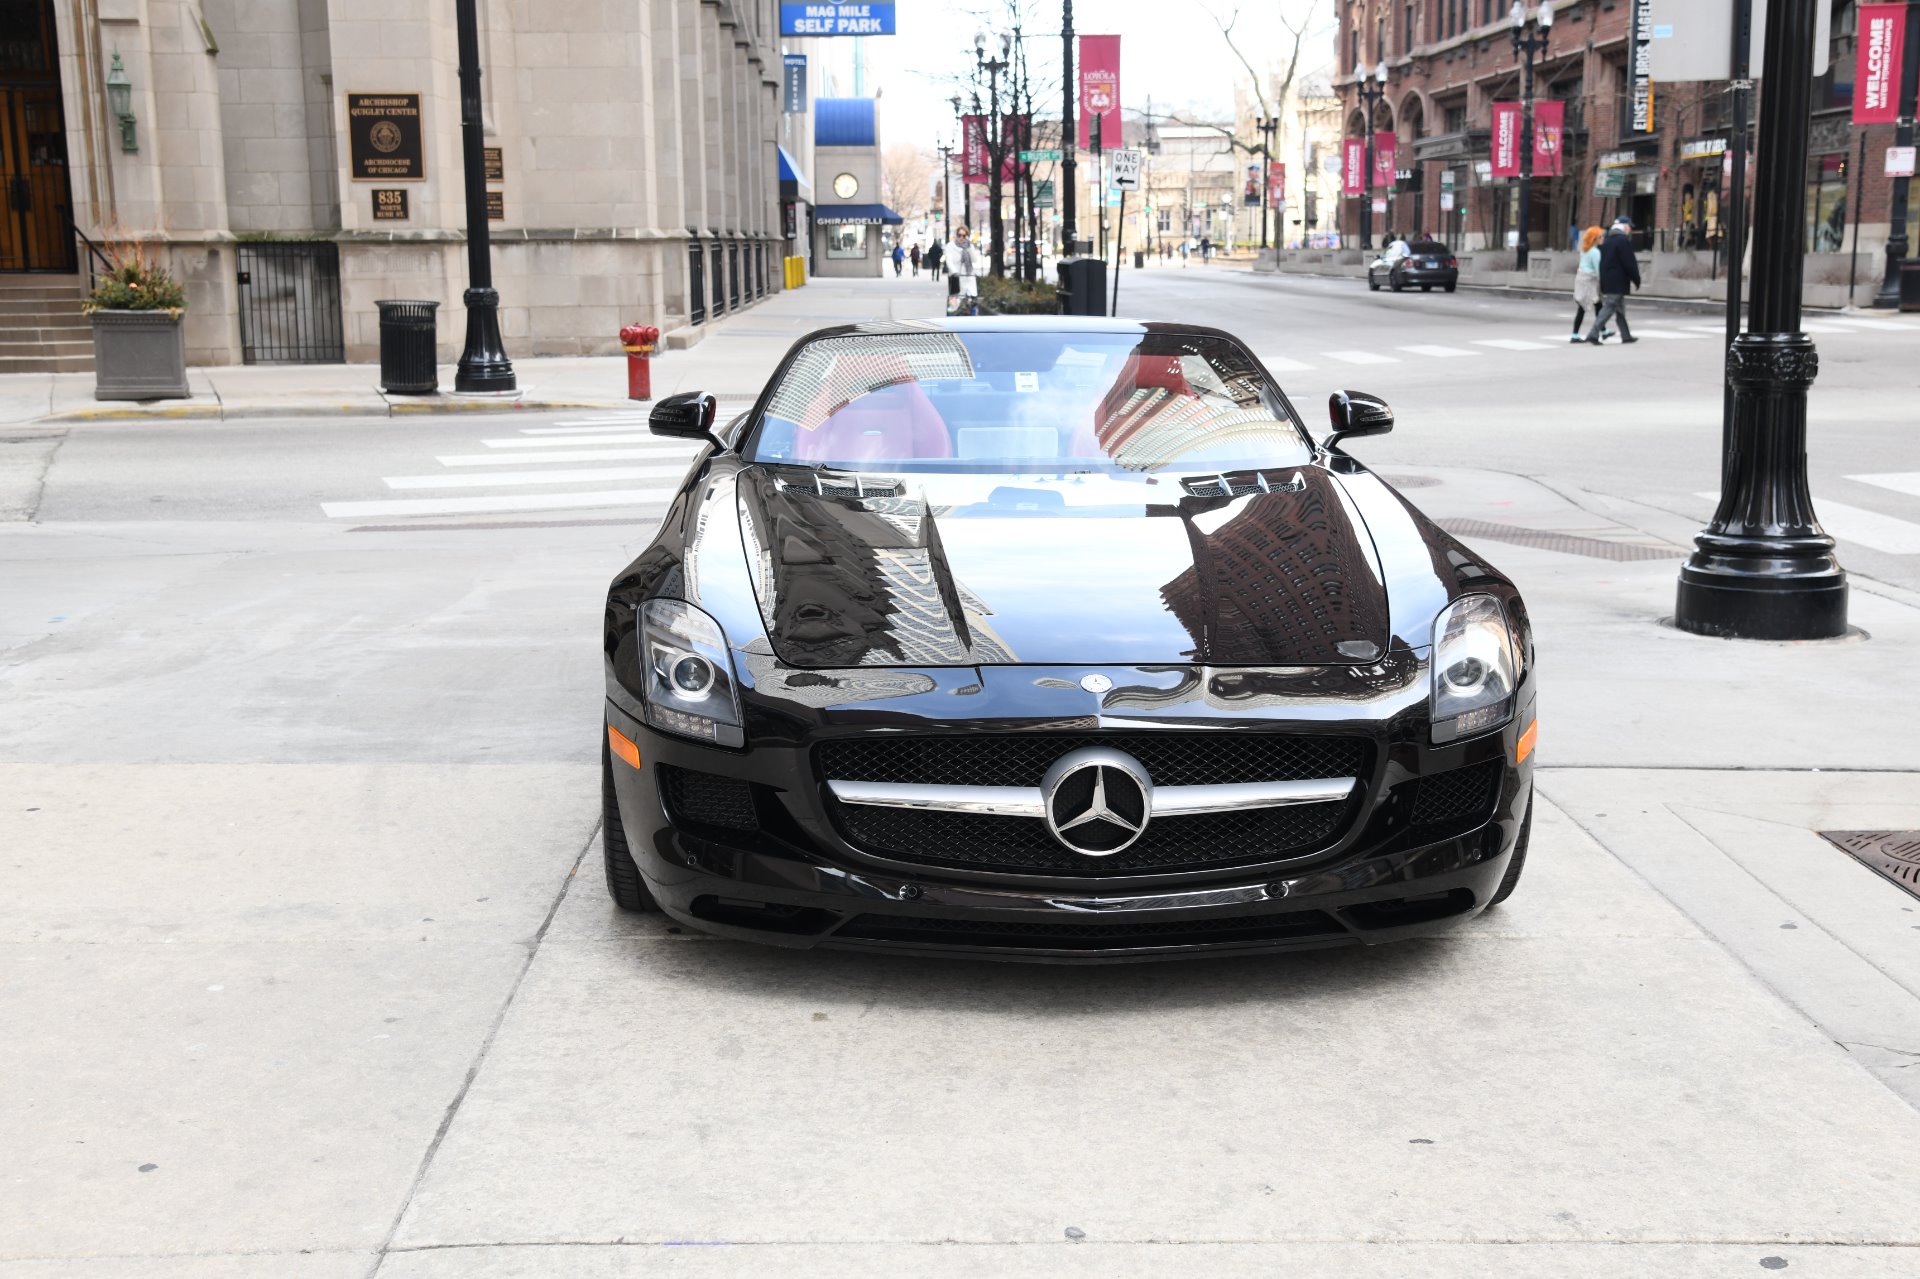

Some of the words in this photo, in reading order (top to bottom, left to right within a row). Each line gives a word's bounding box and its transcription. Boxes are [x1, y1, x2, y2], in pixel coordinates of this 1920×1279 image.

[806, 6, 836, 17] MAG
[838, 5, 870, 17] MILE
[794, 19, 834, 33] SELF
[838, 19, 882, 33] PARK
[1883, 18, 1893, 52] CAMPUS
[1865, 18, 1884, 109] WELCOME
[1881, 53, 1891, 81] TOWER
[1083, 71, 1116, 81] LOYOLA
[1880, 81, 1889, 109] WATER
[359, 98, 409, 106] ARCHBISHOP
[351, 108, 386, 116] QUIGLEY
[386, 108, 418, 116] CENTER
[1498, 111, 1508, 168] WELCOME
[1116, 152, 1138, 163] ONE
[1115, 165, 1138, 174] WAY
[378, 191, 402, 205] 835
[817, 217, 883, 226] GHIRARDELLI
